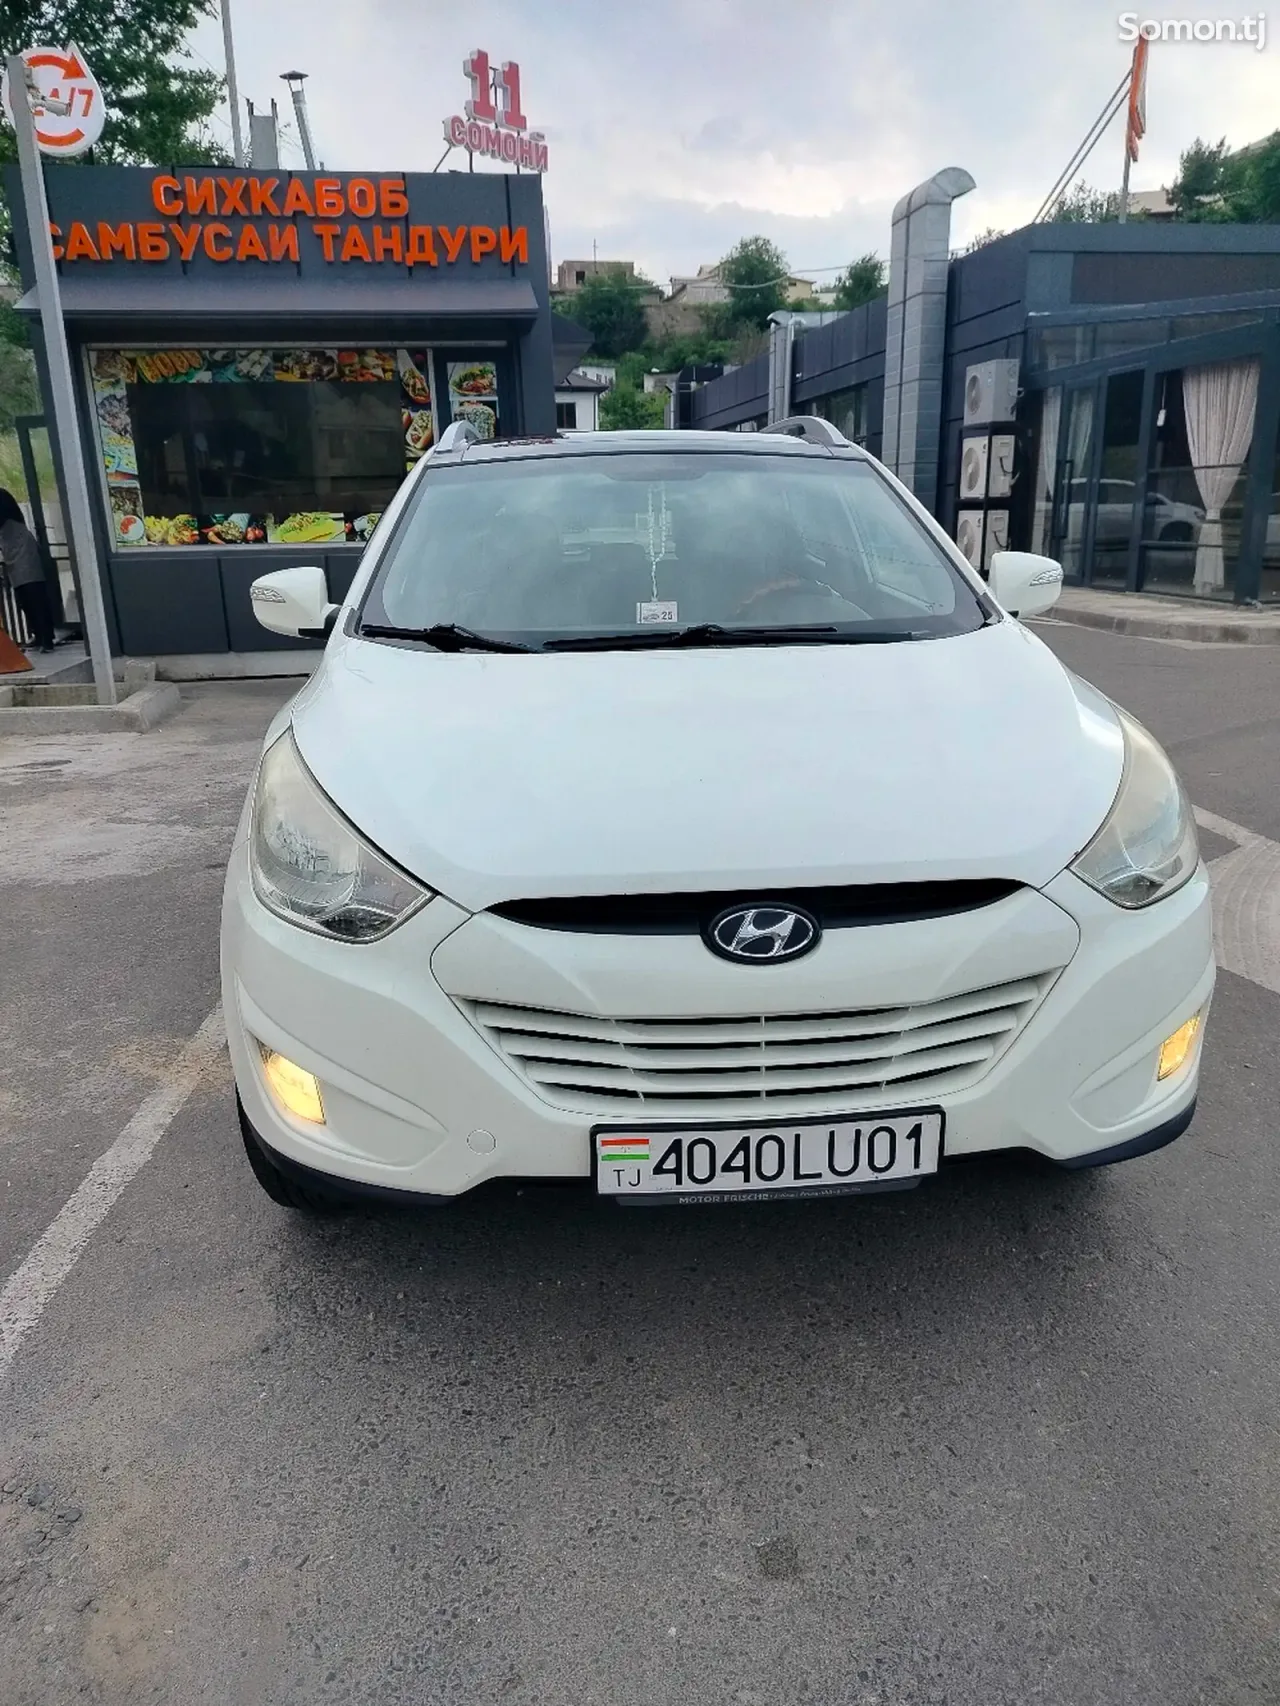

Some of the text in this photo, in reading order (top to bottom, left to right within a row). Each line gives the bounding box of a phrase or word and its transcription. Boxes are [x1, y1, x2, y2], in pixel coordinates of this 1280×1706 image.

[463, 48, 527, 131] 11
[152, 175, 409, 218] СИХКАБОБ
[313, 224, 529, 267] ТАНДУРИ
[652, 1122, 923, 1186] 4040LU01
[612, 1168, 641, 1187] TJ
[679, 1195, 720, 1204] MOTOR
